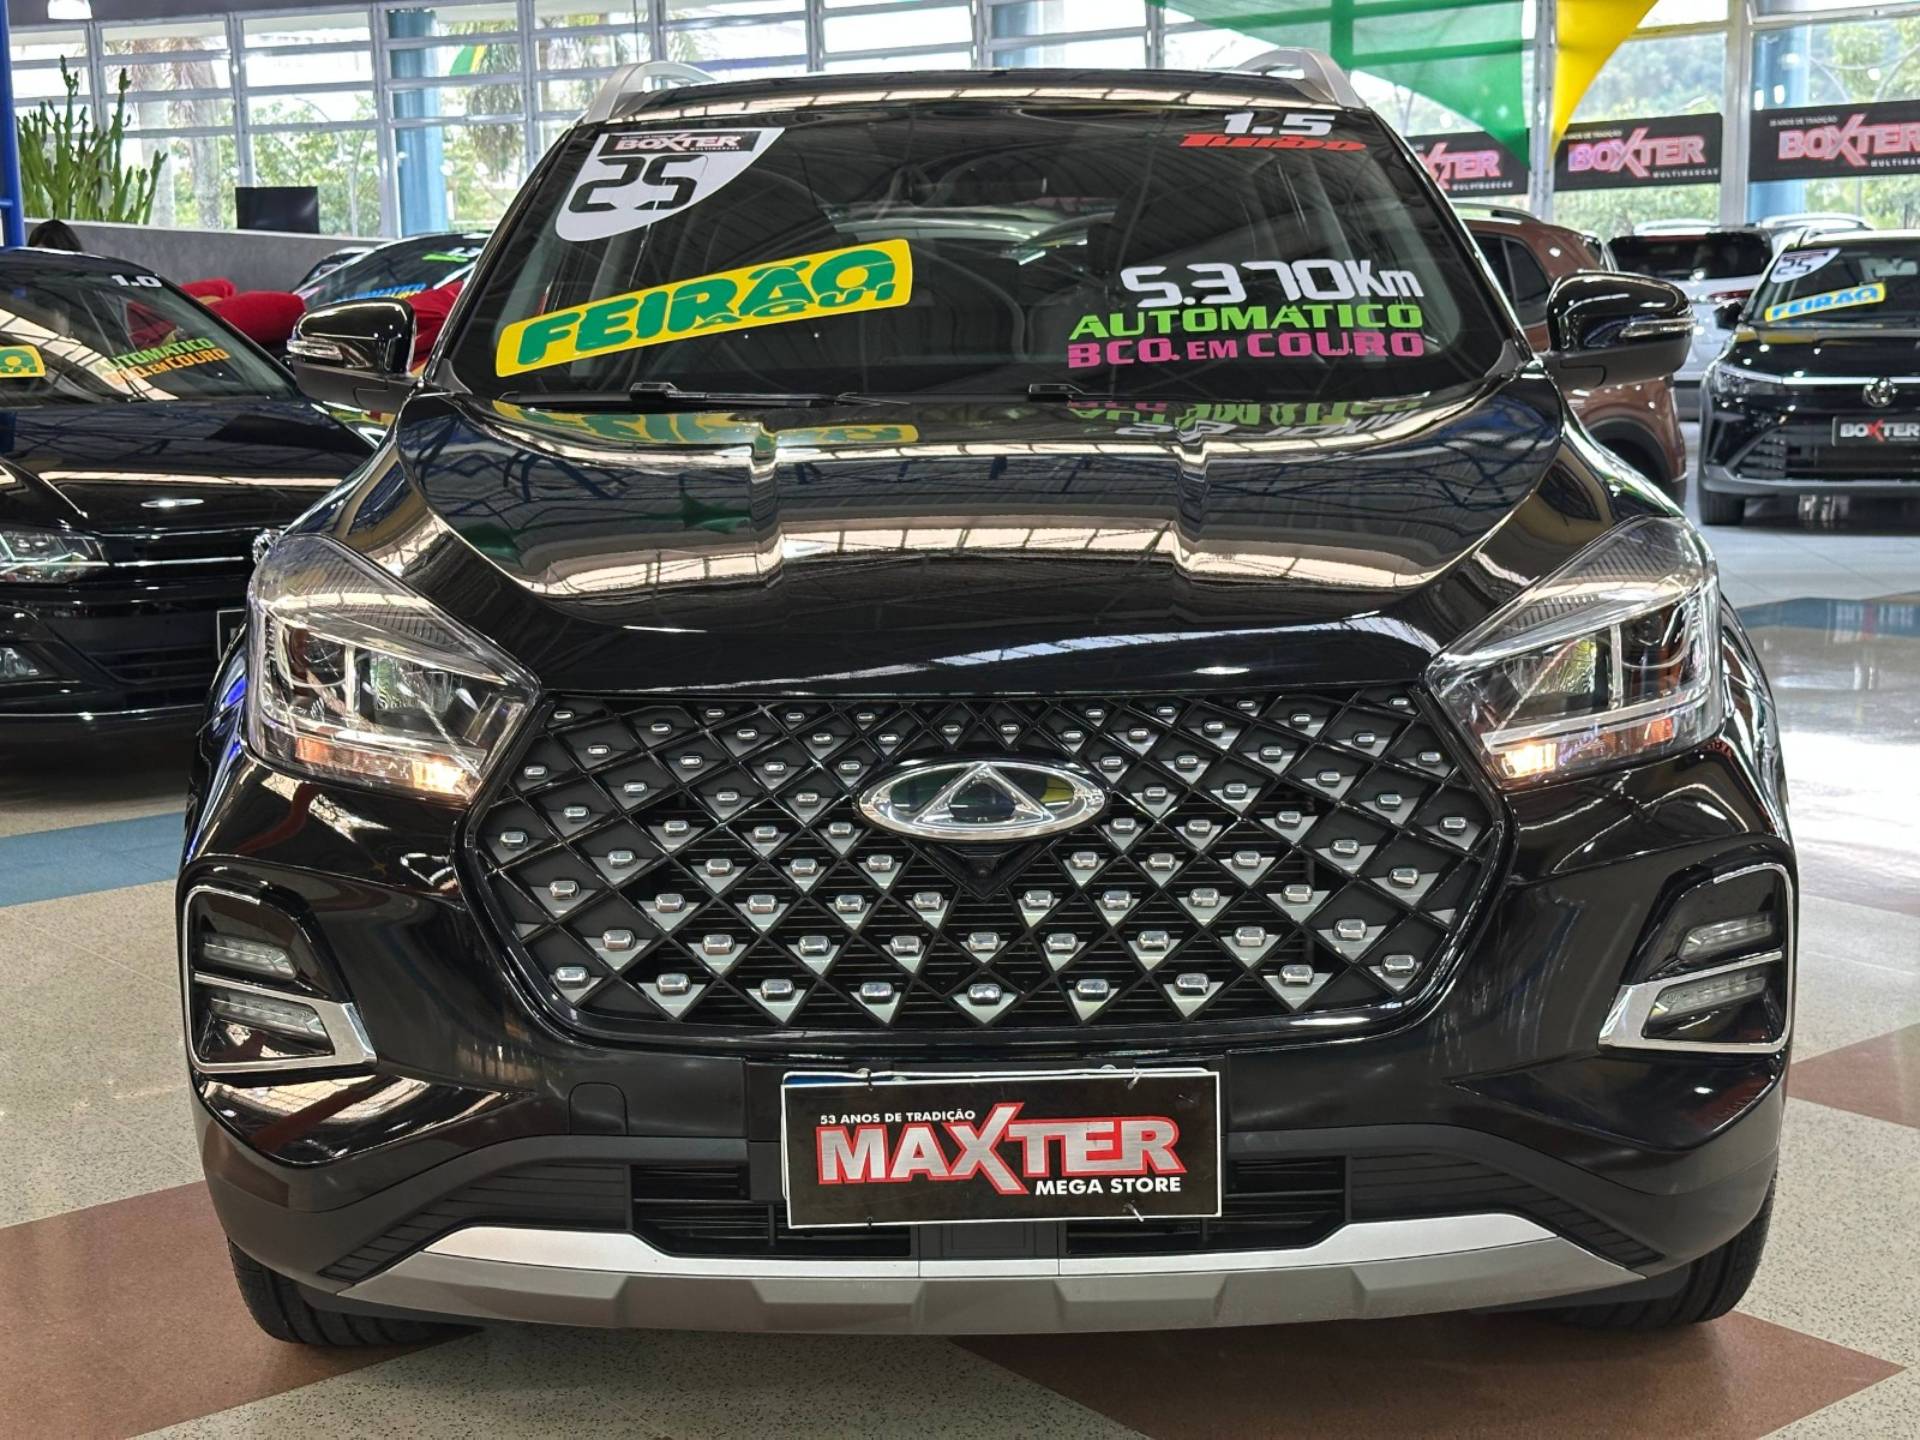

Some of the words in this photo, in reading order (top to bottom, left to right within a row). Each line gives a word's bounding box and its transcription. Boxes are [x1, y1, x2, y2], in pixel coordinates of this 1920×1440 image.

[615, 133, 743, 152] BOXTER
[1224, 111, 1336, 136] 1.5
[1778, 113, 1920, 167] BOXTER
[1417, 142, 1502, 190] XTER
[1568, 127, 1706, 178] BOXTER
[568, 154, 707, 213] 25
[111, 274, 163, 288] 1.0
[1120, 259, 1424, 308] 5.370Km
[517, 249, 897, 365] FEIRÃO
[1186, 339, 1239, 361] EM
[1247, 332, 1425, 358] COURO
[1840, 418, 1920, 443] BOXTER
[820, 1114, 836, 1125] 53
[840, 1113, 880, 1124] ANOS
[884, 1112, 902, 1123] DE
[905, 1108, 976, 1123] TRADIÇÃO
[815, 1102, 1188, 1195] MAXTER
[1035, 1179, 1104, 1196] MEGA
[1110, 1176, 1182, 1193] STORE
